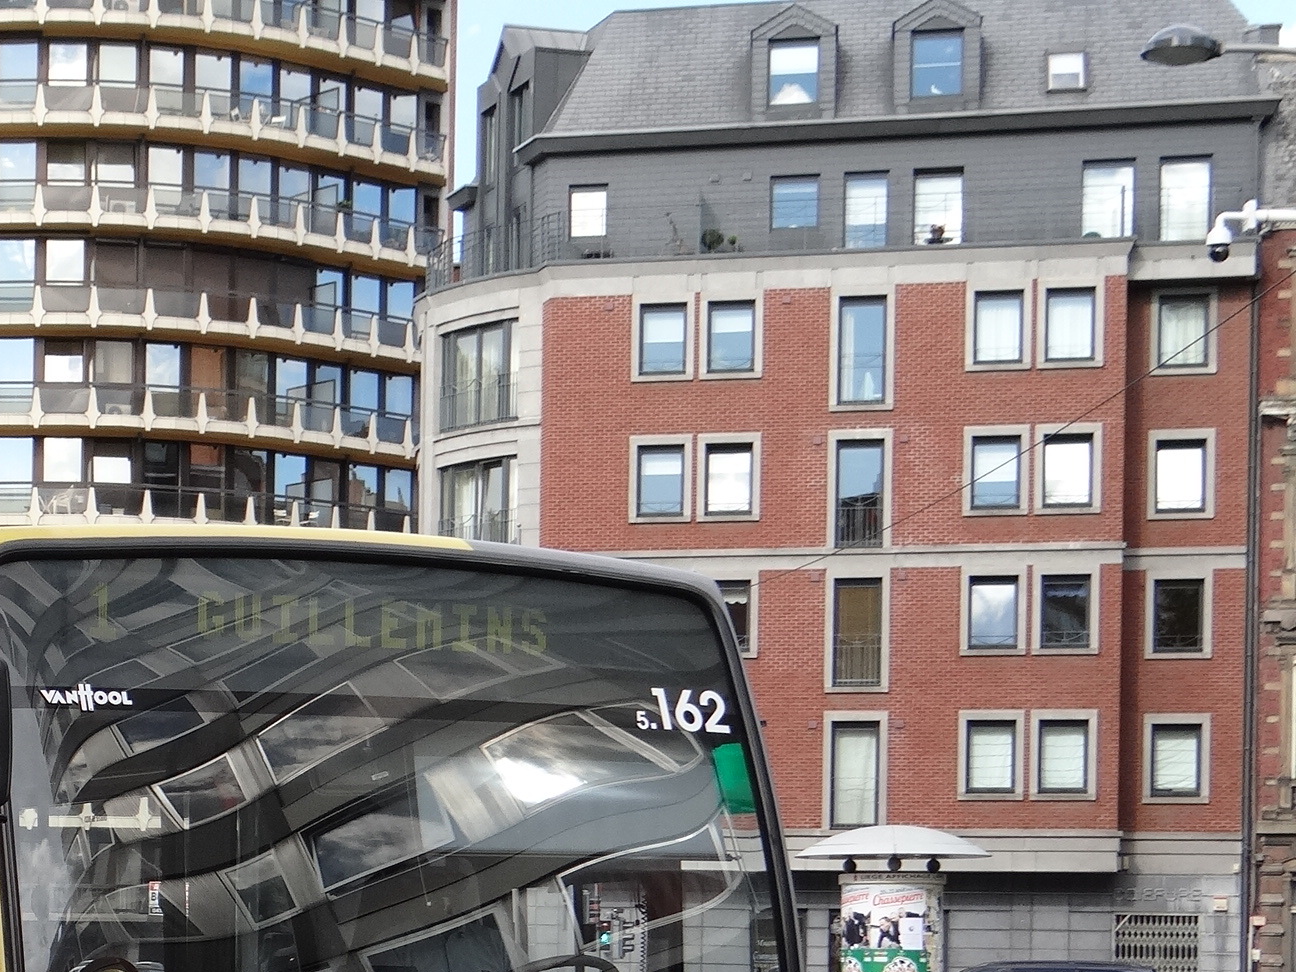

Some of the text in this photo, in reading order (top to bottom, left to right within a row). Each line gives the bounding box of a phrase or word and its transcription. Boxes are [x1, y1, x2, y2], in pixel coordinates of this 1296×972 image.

[196, 591, 549, 656] GUILLEMINS
[39, 683, 133, 713] VANHOOL
[635, 687, 732, 735] 5.162
